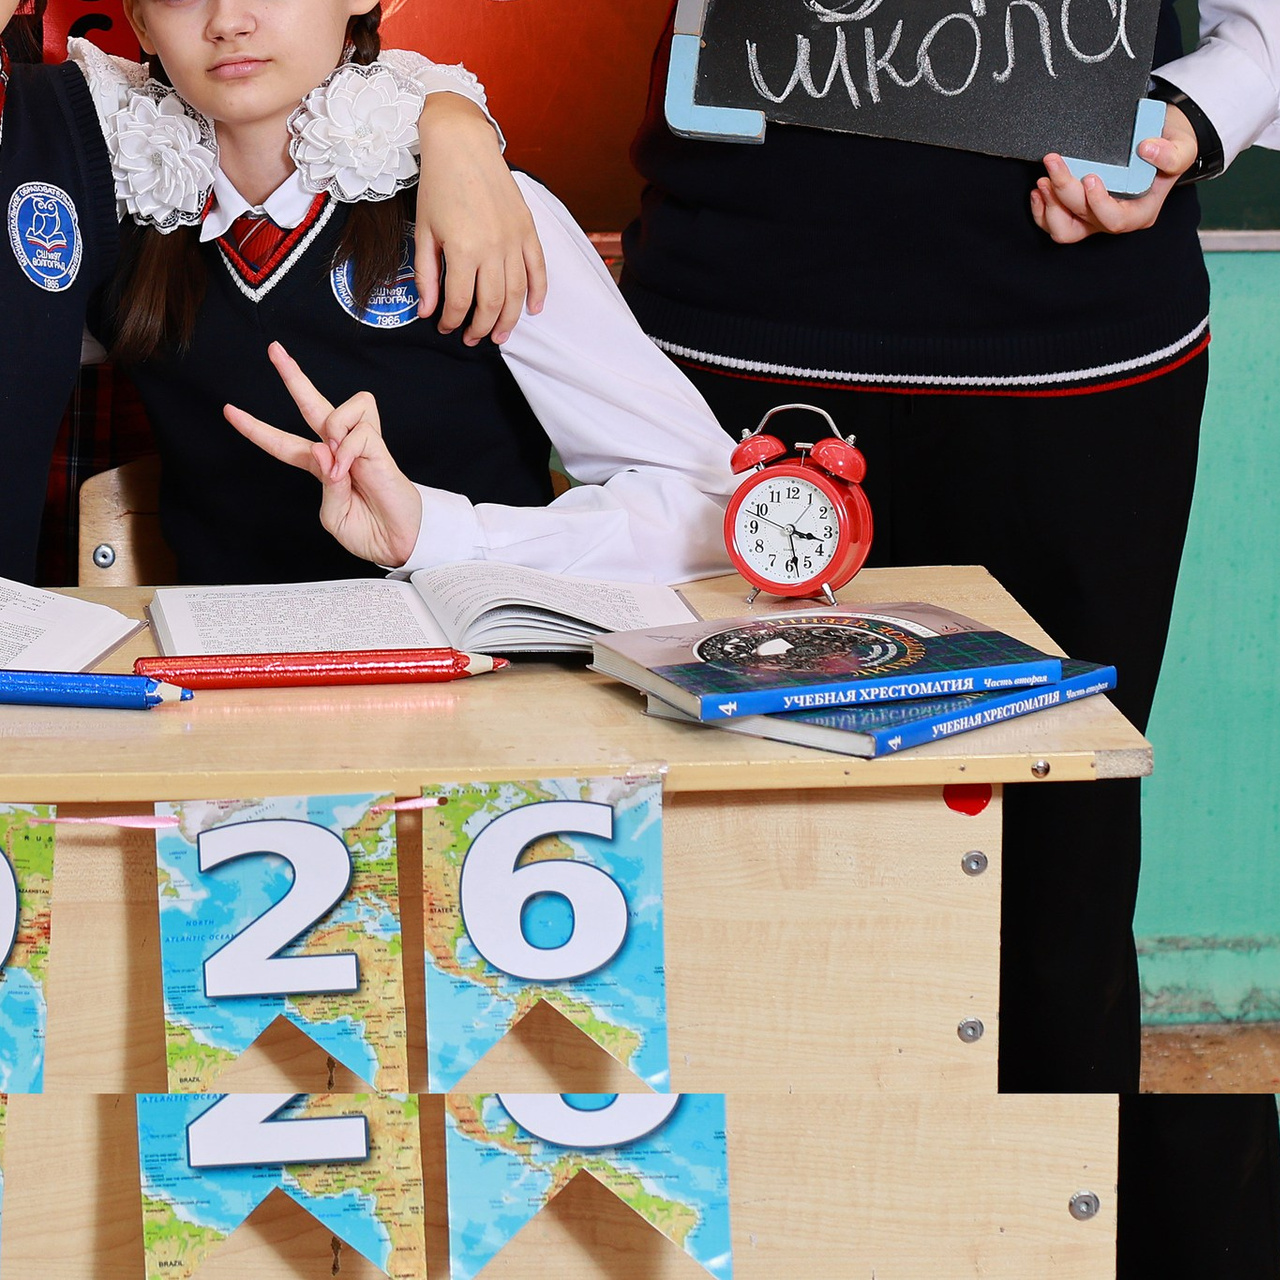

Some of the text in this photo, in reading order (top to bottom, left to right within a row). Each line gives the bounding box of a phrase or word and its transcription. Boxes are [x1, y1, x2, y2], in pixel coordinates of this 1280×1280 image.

[376, 315, 401, 326] 1965
[770, 490, 781, 503] 11
[785, 486, 801, 500] 12
[807, 493, 813, 505] 1
[756, 503, 769, 517] 10
[819, 506, 828, 520] 2
[749, 520, 759, 535] 9
[823, 525, 833, 539] 3
[754, 539, 764, 553] 8
[814, 543, 825, 557] 4
[768, 554, 777, 567] 7
[785, 560, 794, 573] 6
[803, 556, 812, 569] 5
[783, 692, 857, 709] УЧЕБНАЯ
[859, 677, 975, 701] ХРЕСТОМАТИЯ
[983, 677, 1013, 688] Часть
[1014, 673, 1048, 687] вторая
[931, 712, 982, 738] УЧЕБНАЯ
[983, 690, 1061, 723] ХРЕСТОМАТИЯ
[1065, 688, 1085, 700] Часть
[196, 818, 360, 999] 2
[459, 799, 629, 982] 6
[185, 919, 215, 927] NORTH
[165, 935, 207, 943] ATLANTIC
